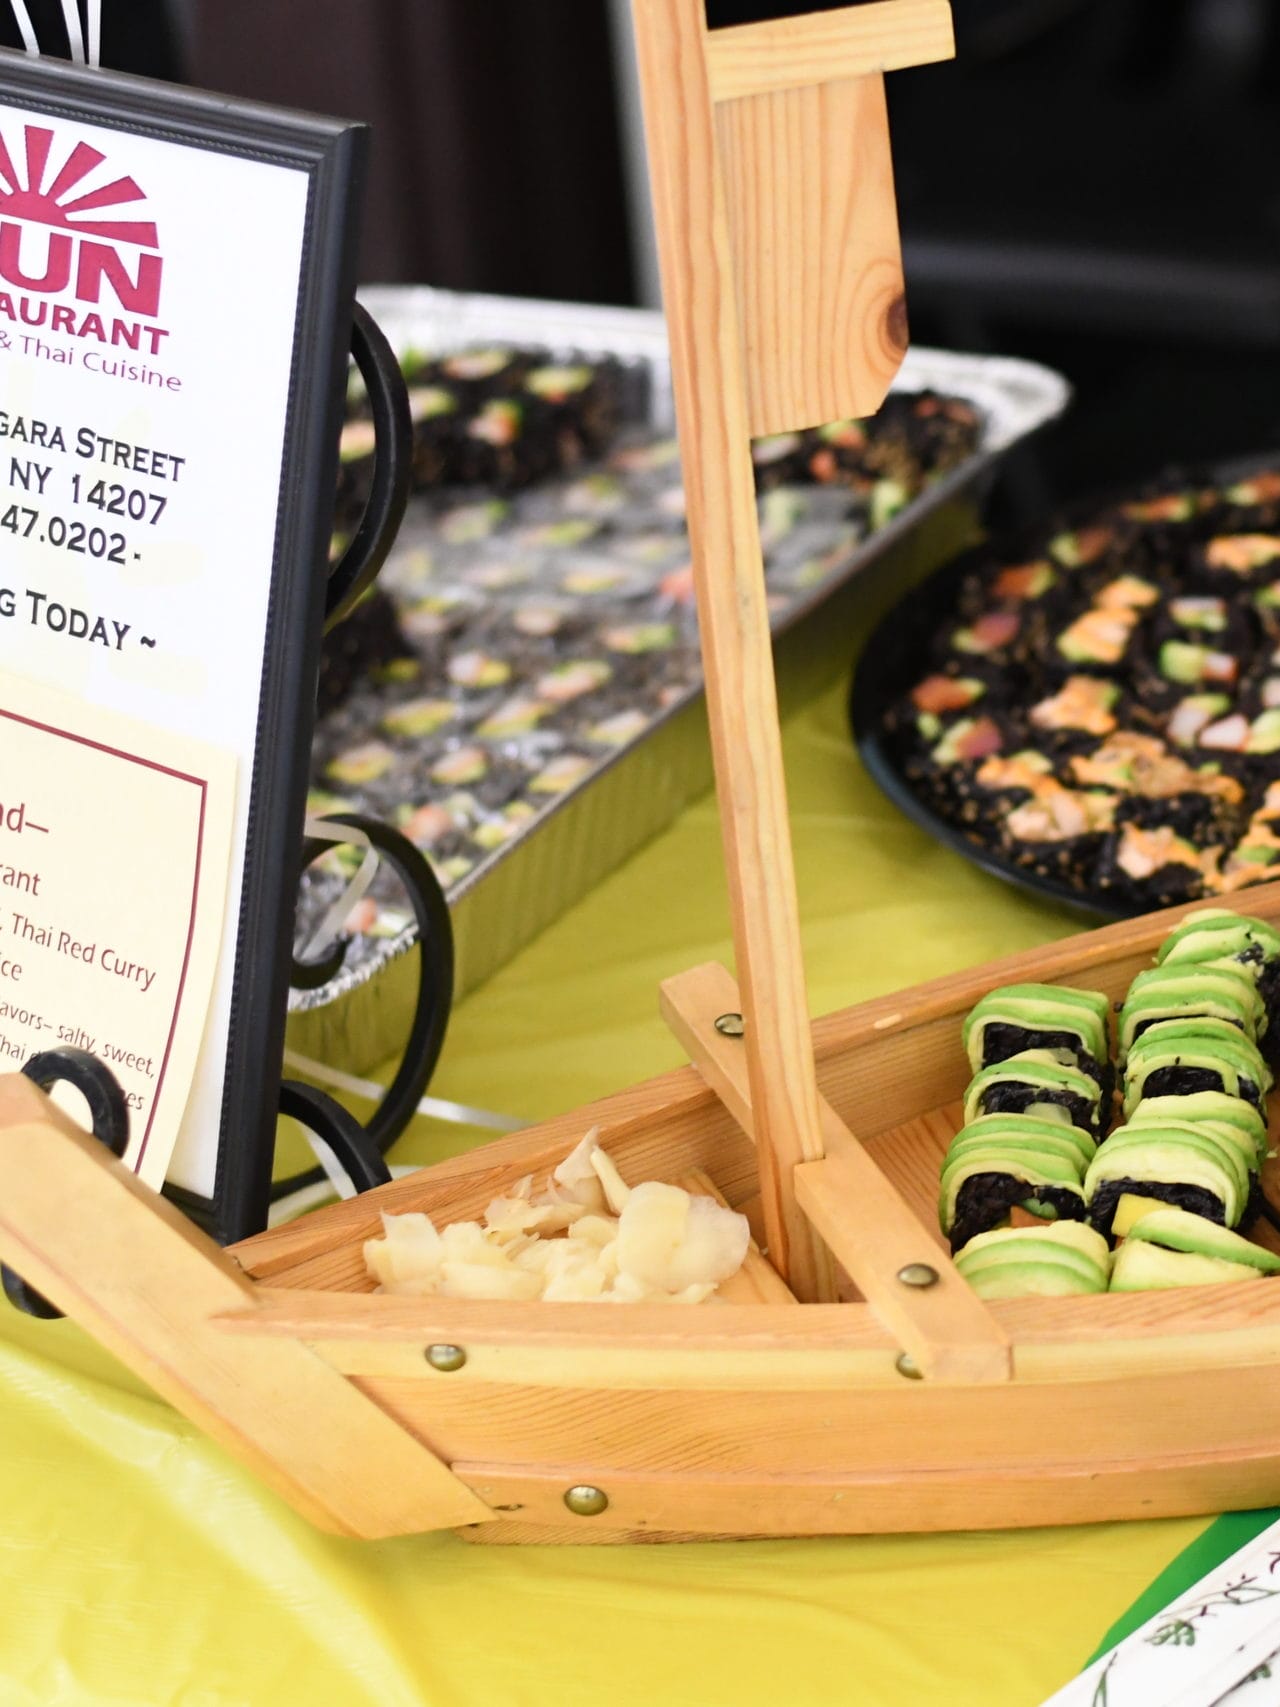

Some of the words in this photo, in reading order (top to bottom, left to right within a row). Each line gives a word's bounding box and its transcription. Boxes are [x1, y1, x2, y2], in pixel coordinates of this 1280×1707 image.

[19, 334, 74, 365] Thai
[83, 352, 182, 391] Cuisine
[9, 457, 53, 495] NY
[72, 473, 168, 525] 14207
[26, 589, 131, 650] TODAY
[0, 951, 23, 981] ce
[12, 912, 53, 948] Thai
[57, 931, 96, 964] Red
[101, 948, 156, 992] Curry
[56, 1024, 96, 1055] salty,
[102, 1043, 155, 1079] sweet,
